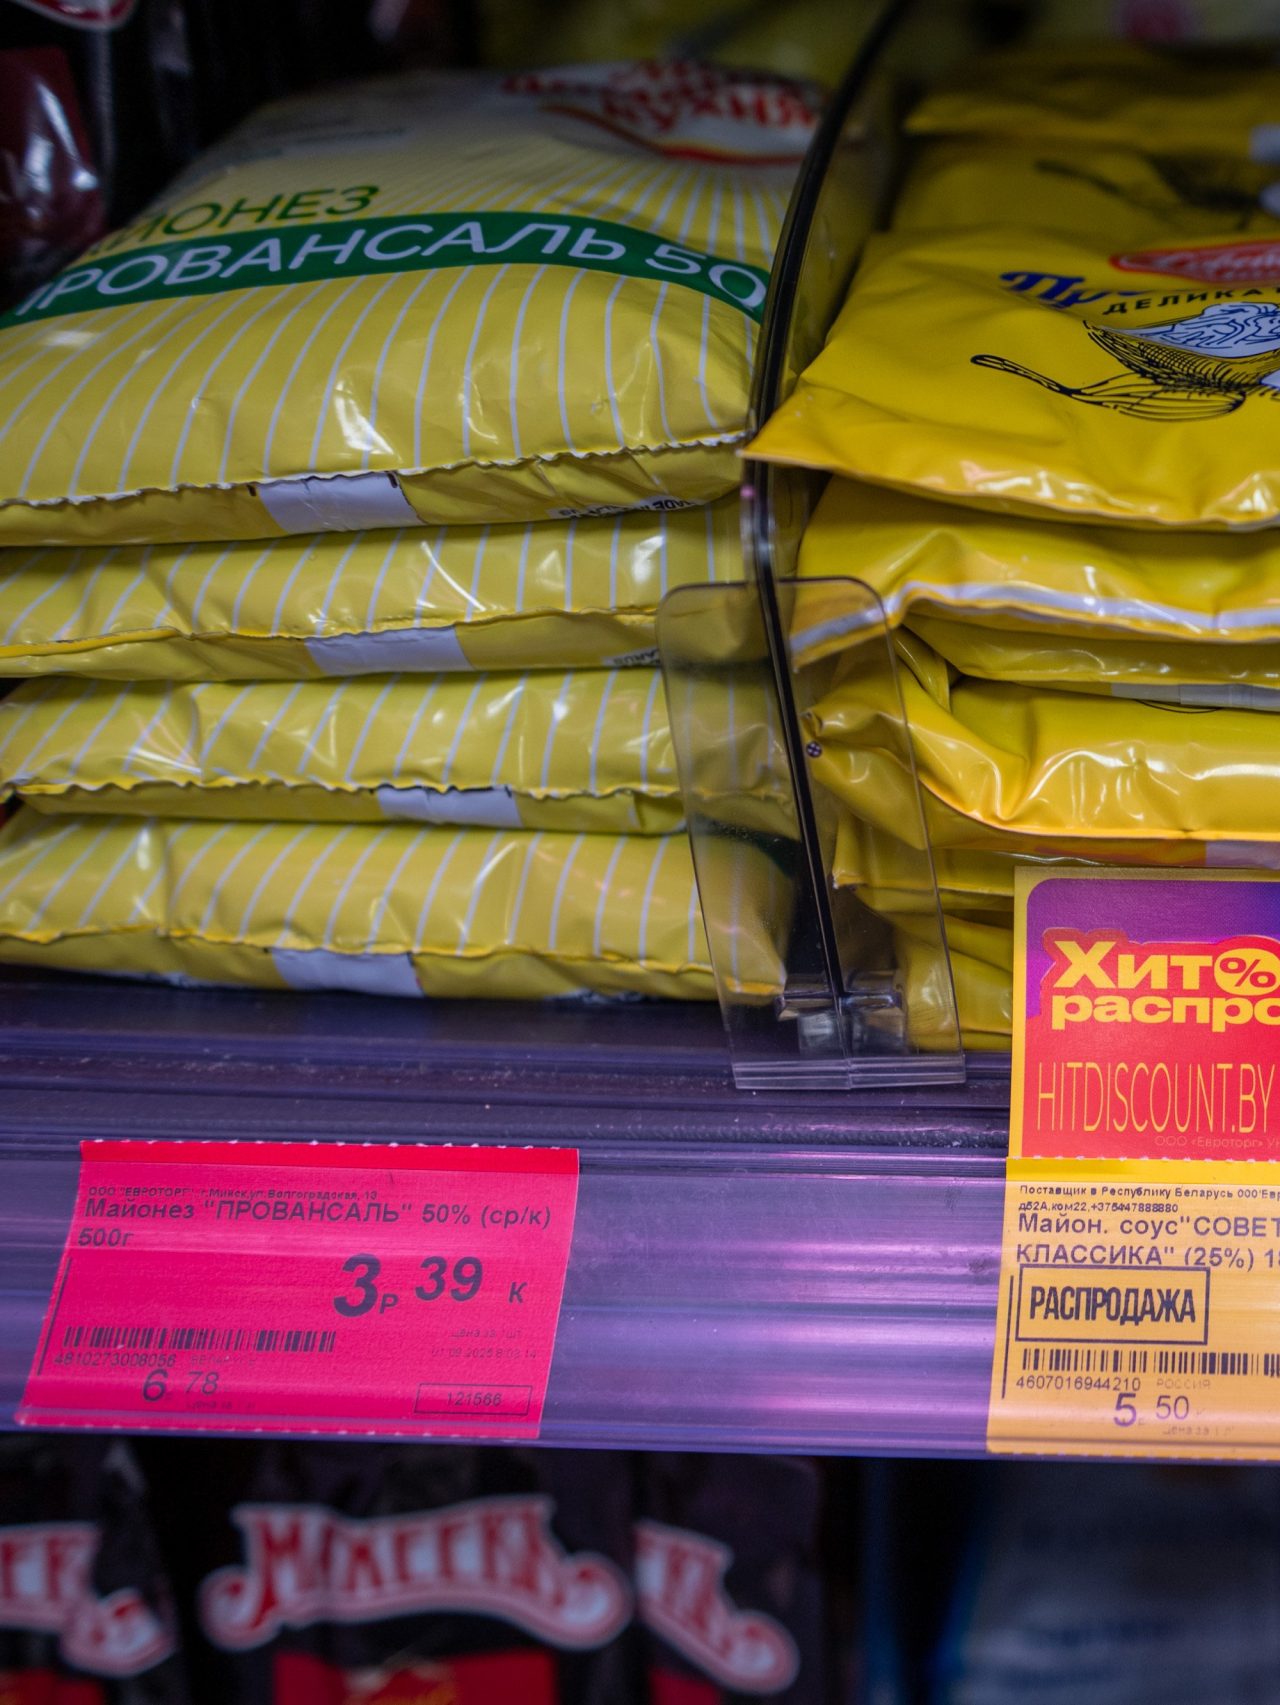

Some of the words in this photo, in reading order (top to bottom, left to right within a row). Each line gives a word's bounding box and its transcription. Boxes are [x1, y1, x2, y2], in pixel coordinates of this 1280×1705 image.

[1036, 1061, 1276, 1134] HITDISCOUNT.BY
[1154, 1135, 1187, 1147] ООО
[1019, 1185, 1087, 1196] Поставщик
[1101, 1186, 1171, 1199] Республику
[1174, 1187, 1233, 1200] Беларусь
[85, 1197, 195, 1219] Майонез
[203, 1200, 412, 1223] "ПРОВАНСАЛЬ"
[421, 1202, 471, 1225] 50%
[481, 1205, 551, 1230] (ср/к)
[1018, 1212, 1108, 1234] Майон.
[78, 1227, 135, 1247] 500г
[1016, 1243, 1175, 1265] КЛАССИКА"
[1184, 1246, 1254, 1272] (25%)
[333, 1252, 382, 1318] 3
[414, 1255, 483, 1302] 39
[1030, 1285, 1196, 1326] РАСПРОДАЖА
[54, 1351, 177, 1368] 4810273008056
[142, 1368, 169, 1403] 6
[184, 1370, 220, 1396] 78
[1016, 1375, 1141, 1392] 4607016944210
[1156, 1378, 1211, 1390] РОССИЯ
[446, 1391, 503, 1407] 121566
[1113, 1391, 1138, 1428] 5
[1155, 1395, 1190, 1421] 50
